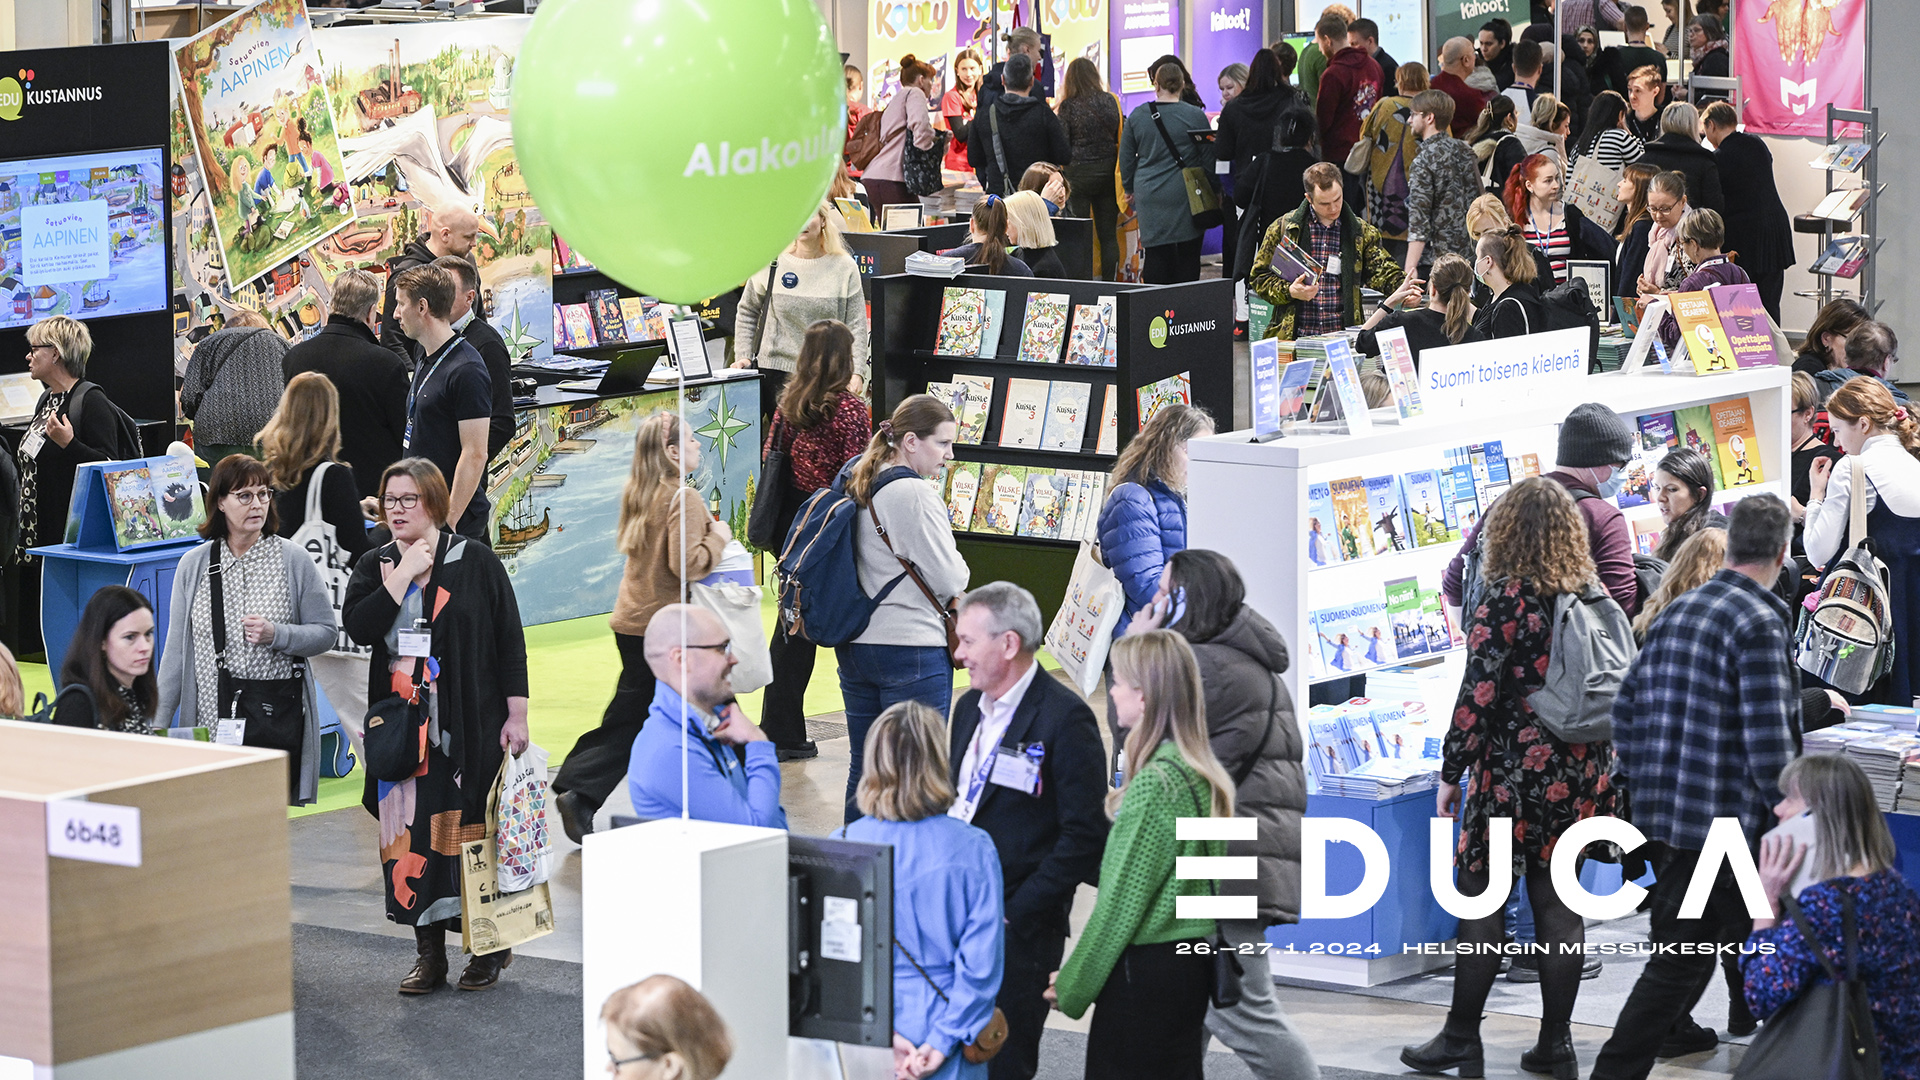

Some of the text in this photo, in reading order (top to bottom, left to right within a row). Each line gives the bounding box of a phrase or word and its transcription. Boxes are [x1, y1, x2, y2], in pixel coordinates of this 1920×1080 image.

[1460, 0, 1510, 20] Kahoot!
[876, 1, 948, 39] KOULU
[1210, 7, 1251, 32] Kahoot!
[229, 40, 270, 66] Satuovien
[220, 42, 291, 98] AAPINEN
[26, 86, 102, 105] KUSTANNUS
[44, 213, 83, 227] Satuovien
[32, 226, 99, 249] AAPINEN
[1677, 299, 1708, 310] OPETTAJAN
[965, 321, 973, 331] 3
[1151, 320, 1216, 338] EDU KUSTANNUS
[1092, 331, 1099, 341] 5
[1730, 333, 1770, 345] Opettajan
[1734, 344, 1773, 355] porinapata
[1430, 349, 1580, 390] Suomi toisena kielenä
[1028, 411, 1036, 420] 3
[1069, 414, 1076, 423] 4
[1715, 408, 1746, 420] OPETTAJAN
[1718, 417, 1746, 428] IDEAREPPU
[954, 481, 975, 490] VILSKE
[997, 485, 1021, 495] VILSKE
[1331, 479, 1360, 495] SUOMEN
[1320, 609, 1351, 624] SUOMEN
[1354, 603, 1382, 617] SUOMEN
[1377, 711, 1402, 724] SUOMEN
